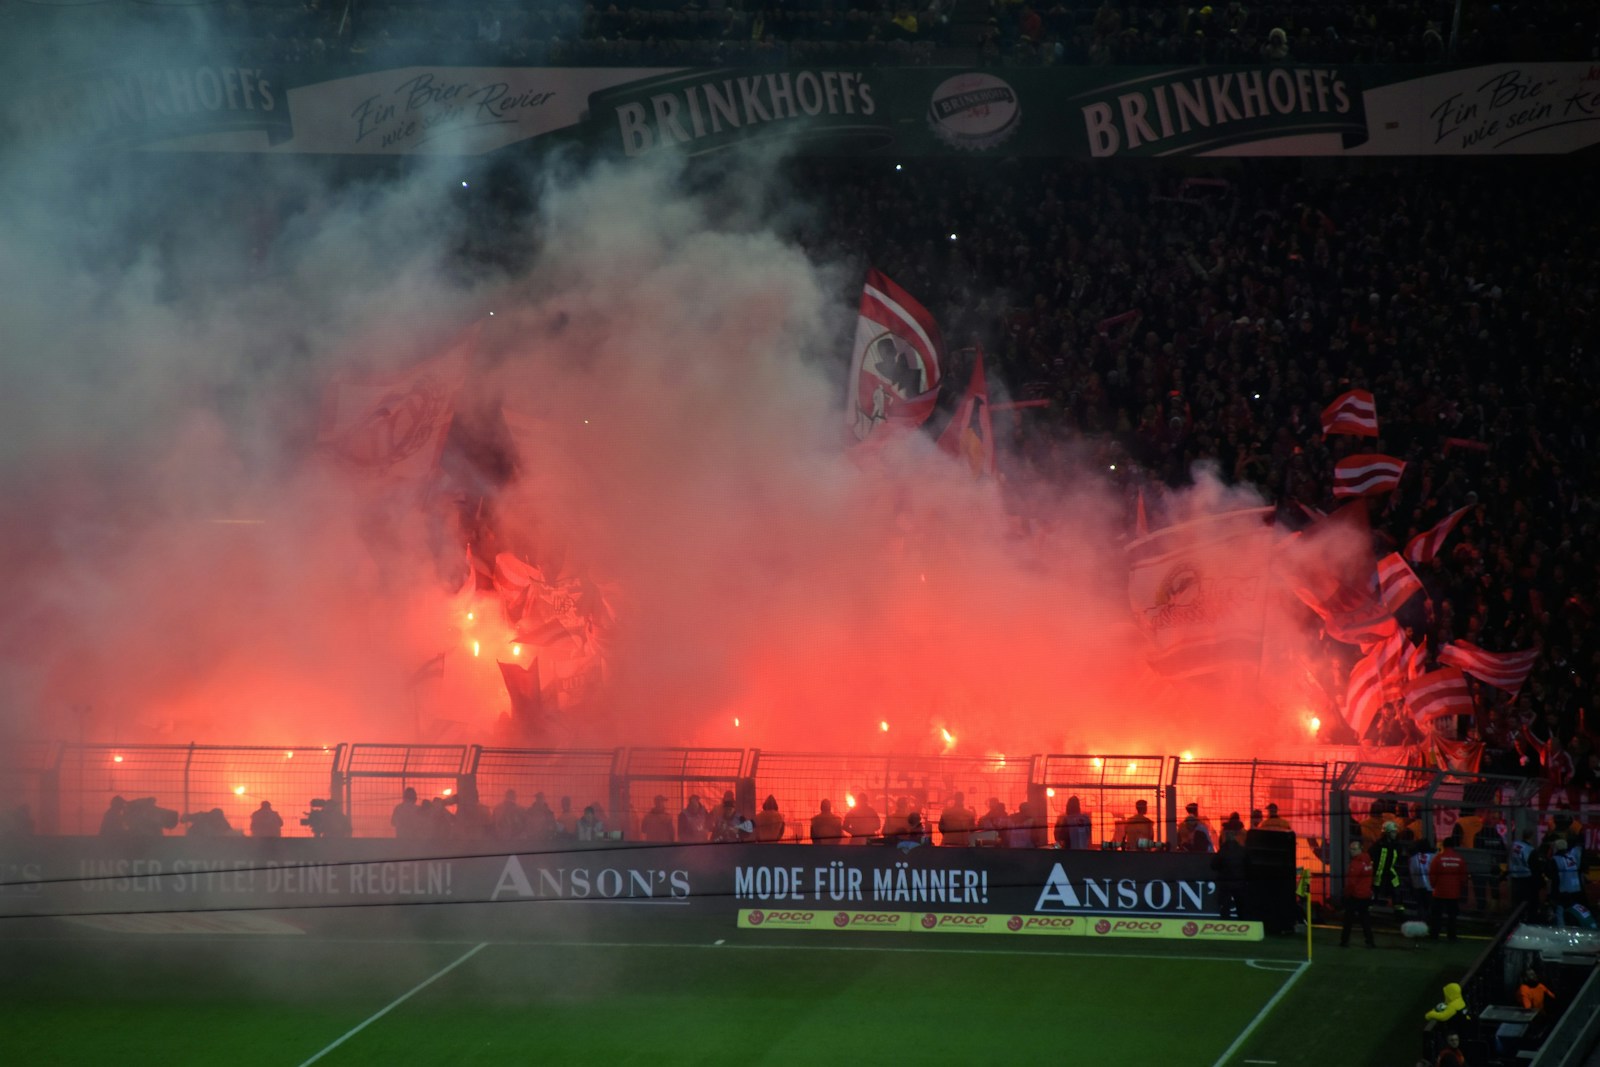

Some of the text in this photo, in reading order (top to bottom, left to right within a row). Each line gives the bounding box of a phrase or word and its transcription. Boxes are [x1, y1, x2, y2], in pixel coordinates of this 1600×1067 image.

[351, 73, 468, 144] Ein Bier
[381, 120, 416, 148] wie
[467, 82, 557, 119] Revier
[1081, 68, 1350, 158] BRINKHOFF's
[1429, 92, 1478, 144] Ein
[1461, 120, 1499, 149] wie
[1505, 102, 1553, 129] sein
[80, 859, 453, 896] UNSER STYLE! DEINE REGELN!
[490, 854, 691, 901] ANSON'S
[735, 860, 989, 904] MODE FÜR MÄNNER!
[766, 911, 815, 922] POCO
[851, 913, 901, 924] POCO
[938, 914, 988, 926] POCO
[1025, 917, 1075, 928] POCO
[1112, 920, 1162, 931] POCO
[1201, 922, 1251, 934] POCO
